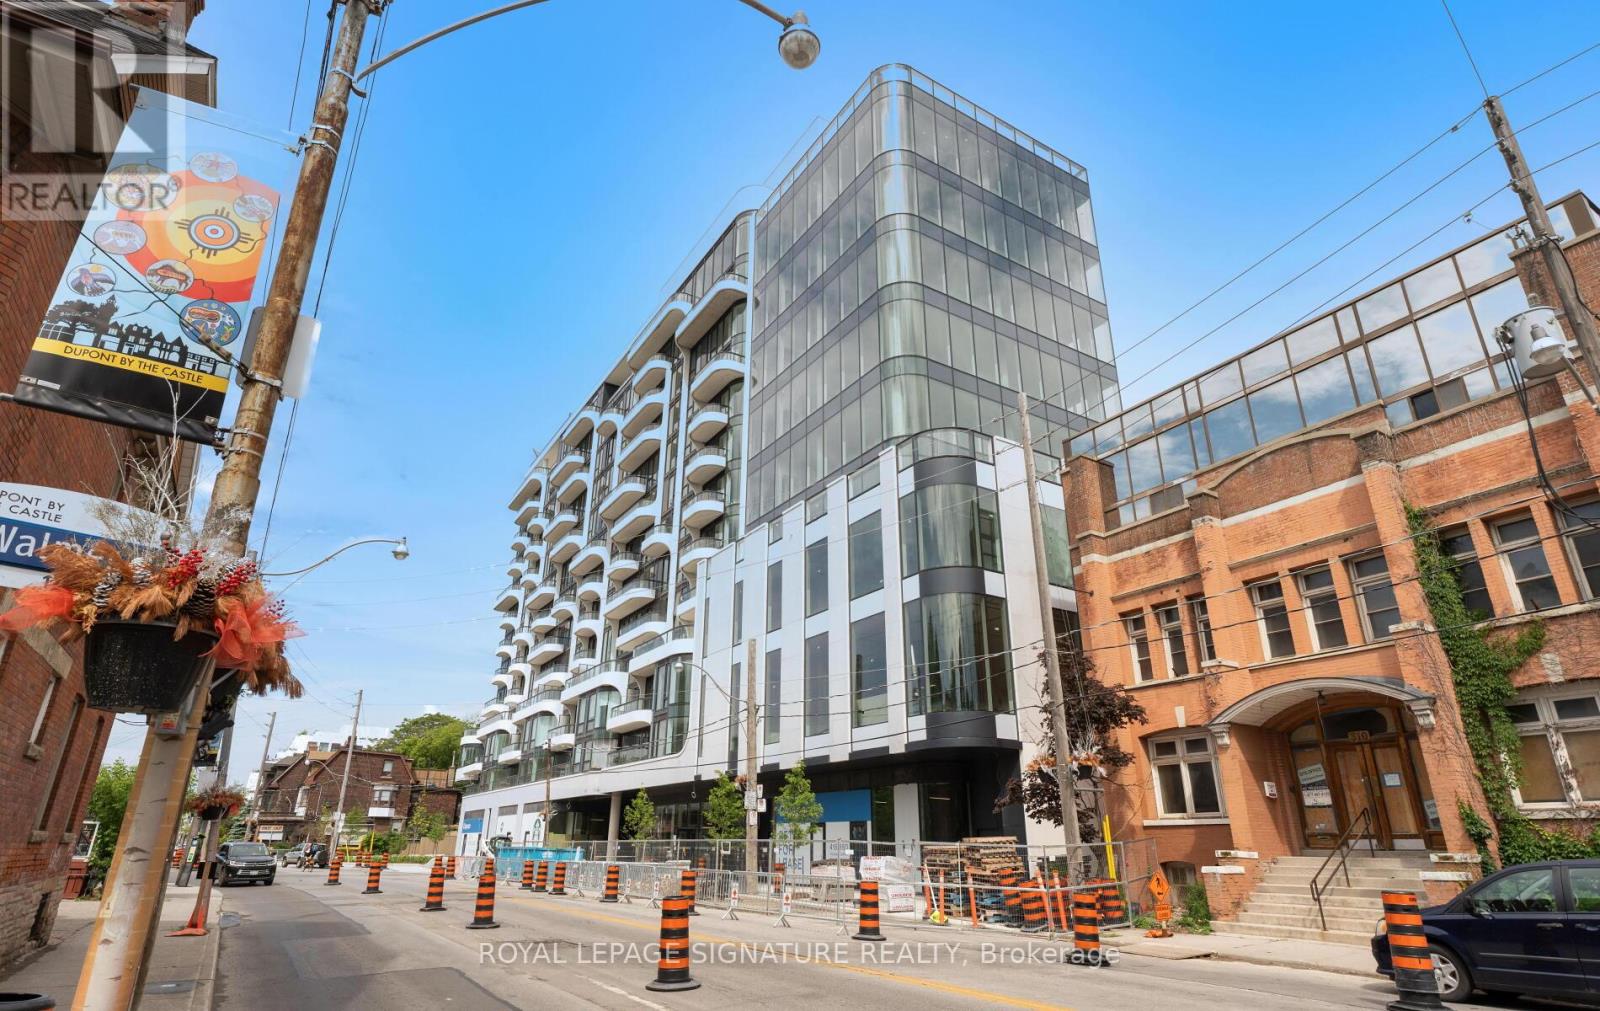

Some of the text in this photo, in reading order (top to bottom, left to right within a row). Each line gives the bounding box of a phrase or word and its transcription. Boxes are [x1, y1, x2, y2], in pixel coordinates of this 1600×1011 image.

[64, 345, 204, 384] DUPONT BY THE CASTLE
[9, 505, 62, 523] CASTLE
[47, 501, 65, 511] BY
